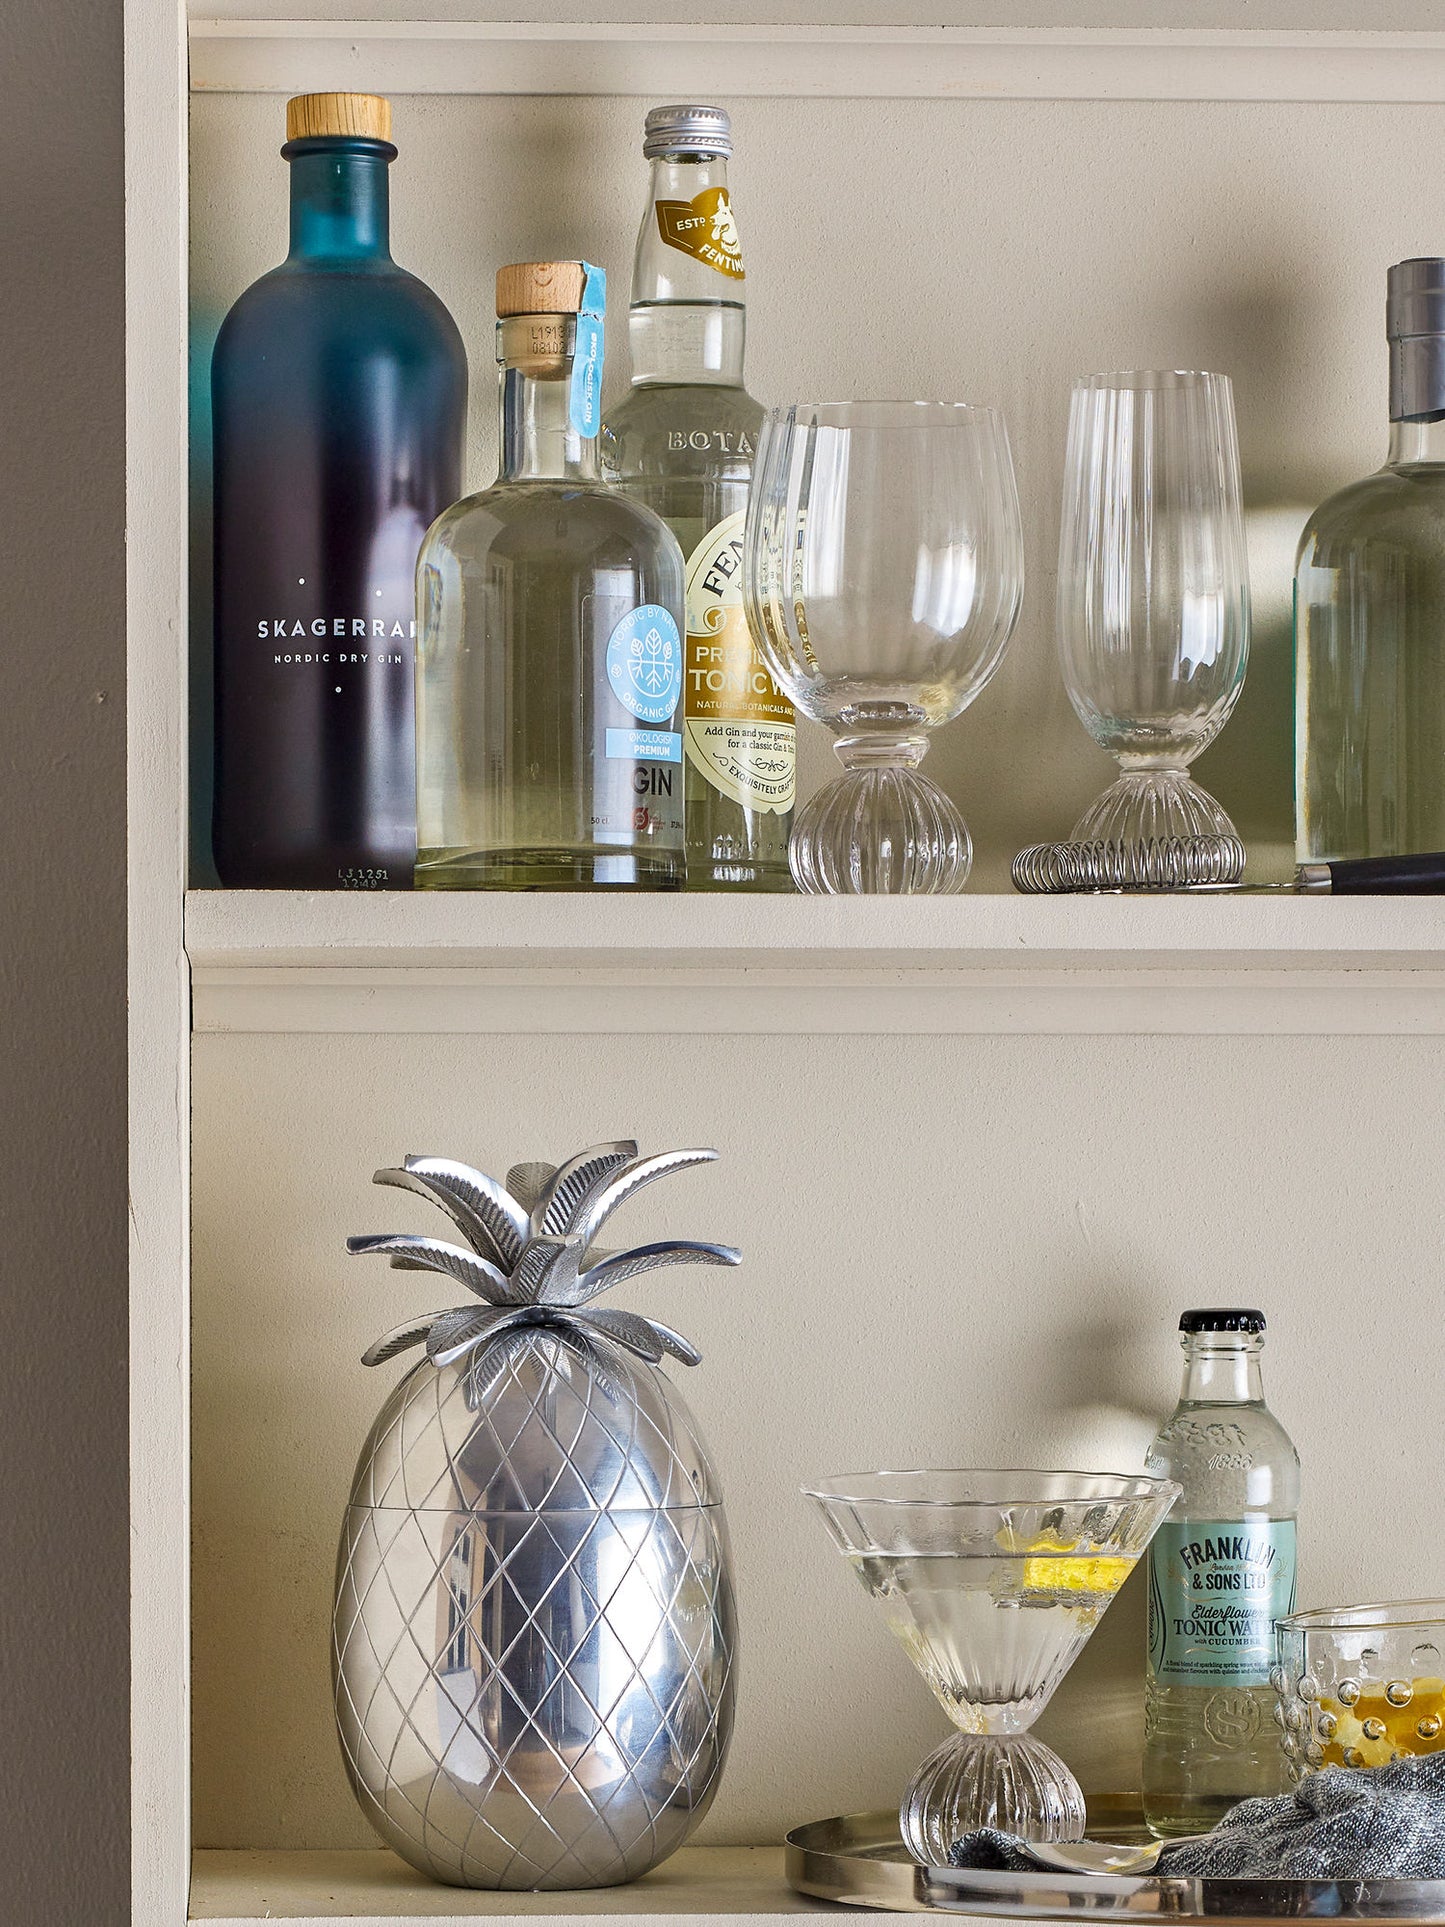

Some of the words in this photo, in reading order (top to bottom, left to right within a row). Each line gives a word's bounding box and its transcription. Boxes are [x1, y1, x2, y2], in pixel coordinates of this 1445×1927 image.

[668, 430, 757, 454] BOTA
[611, 609, 645, 651] NORDIC
[647, 607, 660, 618] BY
[274, 653, 330, 664] NORDIC
[339, 653, 369, 663] DRY
[377, 654, 402, 664] GIN
[688, 668, 768, 695] TONIC
[623, 692, 664, 718] ORGANIC
[742, 702, 784, 714] BOTANICALS
[704, 726, 723, 736] Add
[725, 727, 740, 737] Gin
[741, 728, 757, 737] and
[758, 730, 773, 740] your
[634, 744, 670, 757] PREMIUM
[727, 738, 740, 748] for
[749, 740, 773, 751] classic
[773, 742, 783, 752] Gin
[632, 766, 672, 797] GIN
[728, 765, 777, 795] EXQUISITELY
[1179, 1536, 1276, 1570] FRANKLIN
[1192, 1573, 1203, 1590] &
[1205, 1573, 1241, 1590] SONS
[1244, 1573, 1266, 1590] LTD
[1192, 1604, 1264, 1621] Elderflower
[1173, 1619, 1226, 1636] TONIC
[1200, 1661, 1222, 1669] sparkling
